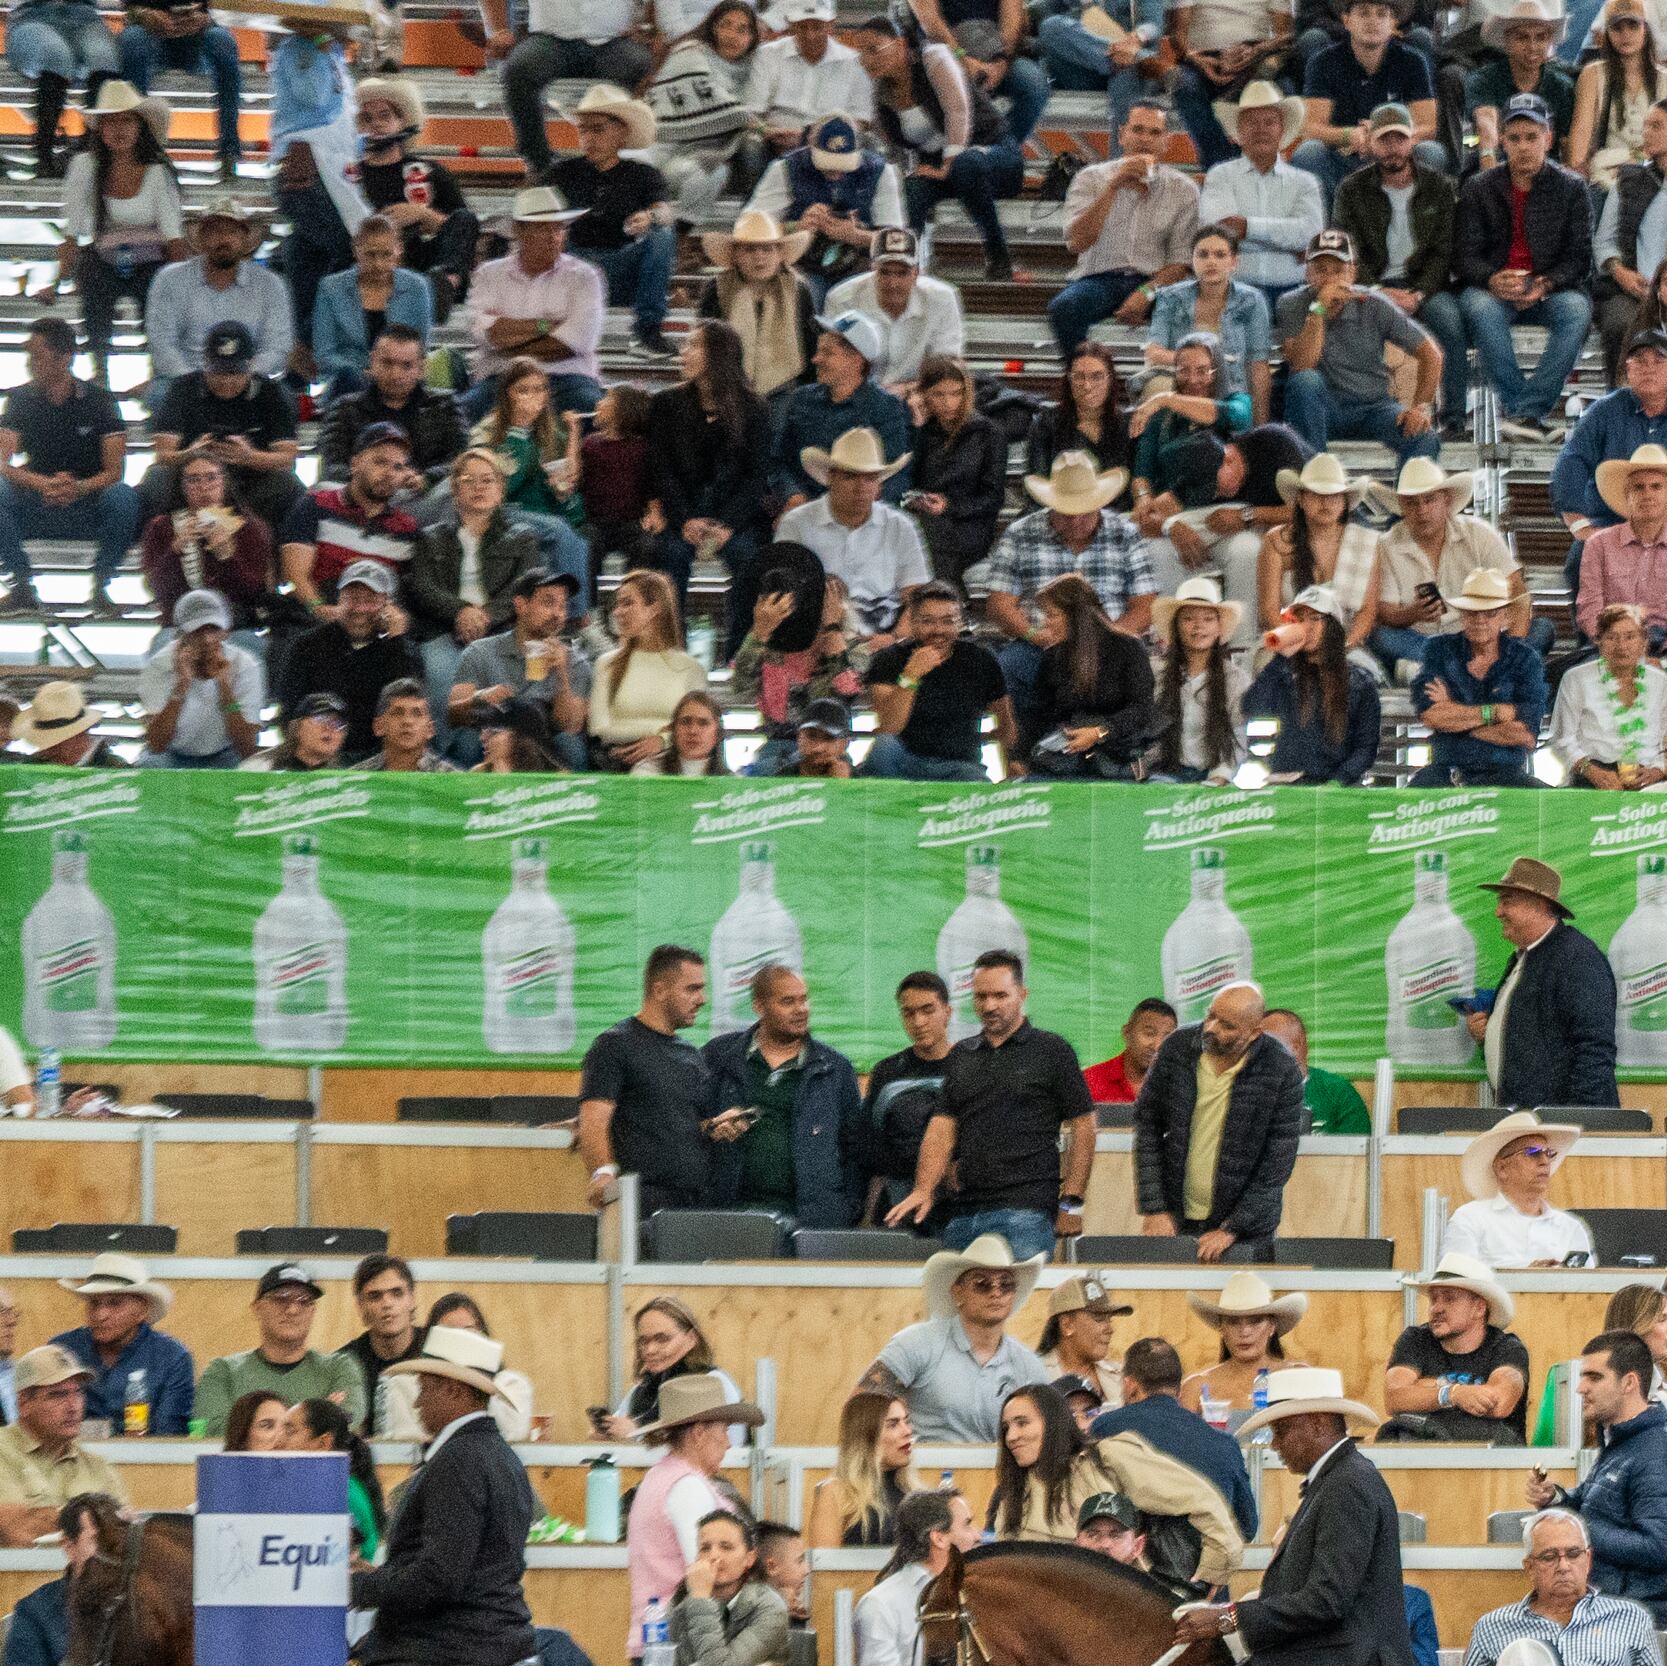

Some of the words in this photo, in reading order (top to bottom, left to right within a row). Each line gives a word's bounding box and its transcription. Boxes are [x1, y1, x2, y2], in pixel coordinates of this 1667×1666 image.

[1396, 799, 1435, 820] Solo
[1437, 795, 1470, 812] con
[1618, 802, 1657, 823] Solo
[1369, 807, 1497, 843] Antioqueño
[259, 1534, 338, 1591] Equi
